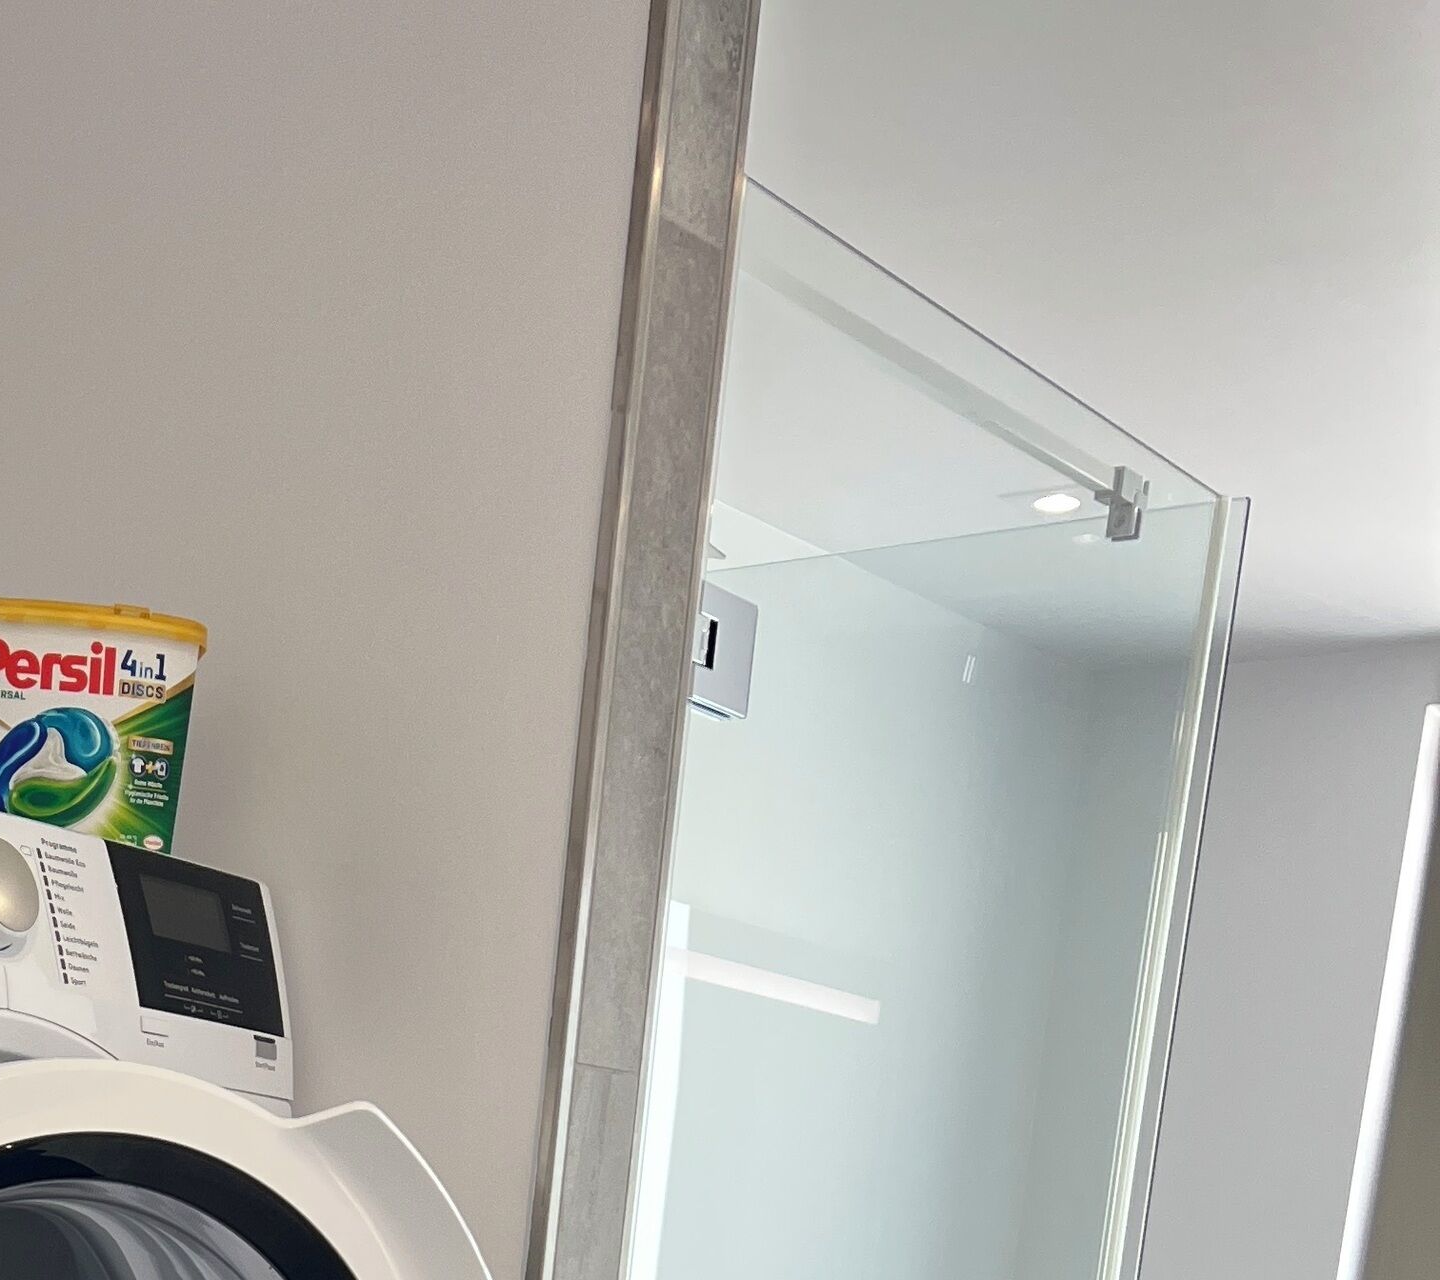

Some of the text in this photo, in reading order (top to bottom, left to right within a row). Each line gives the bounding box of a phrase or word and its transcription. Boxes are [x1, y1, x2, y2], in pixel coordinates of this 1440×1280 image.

[120, 649, 167, 682] 4in1
[121, 683, 164, 699] DISCS
[40, 837, 78, 854] Programme
